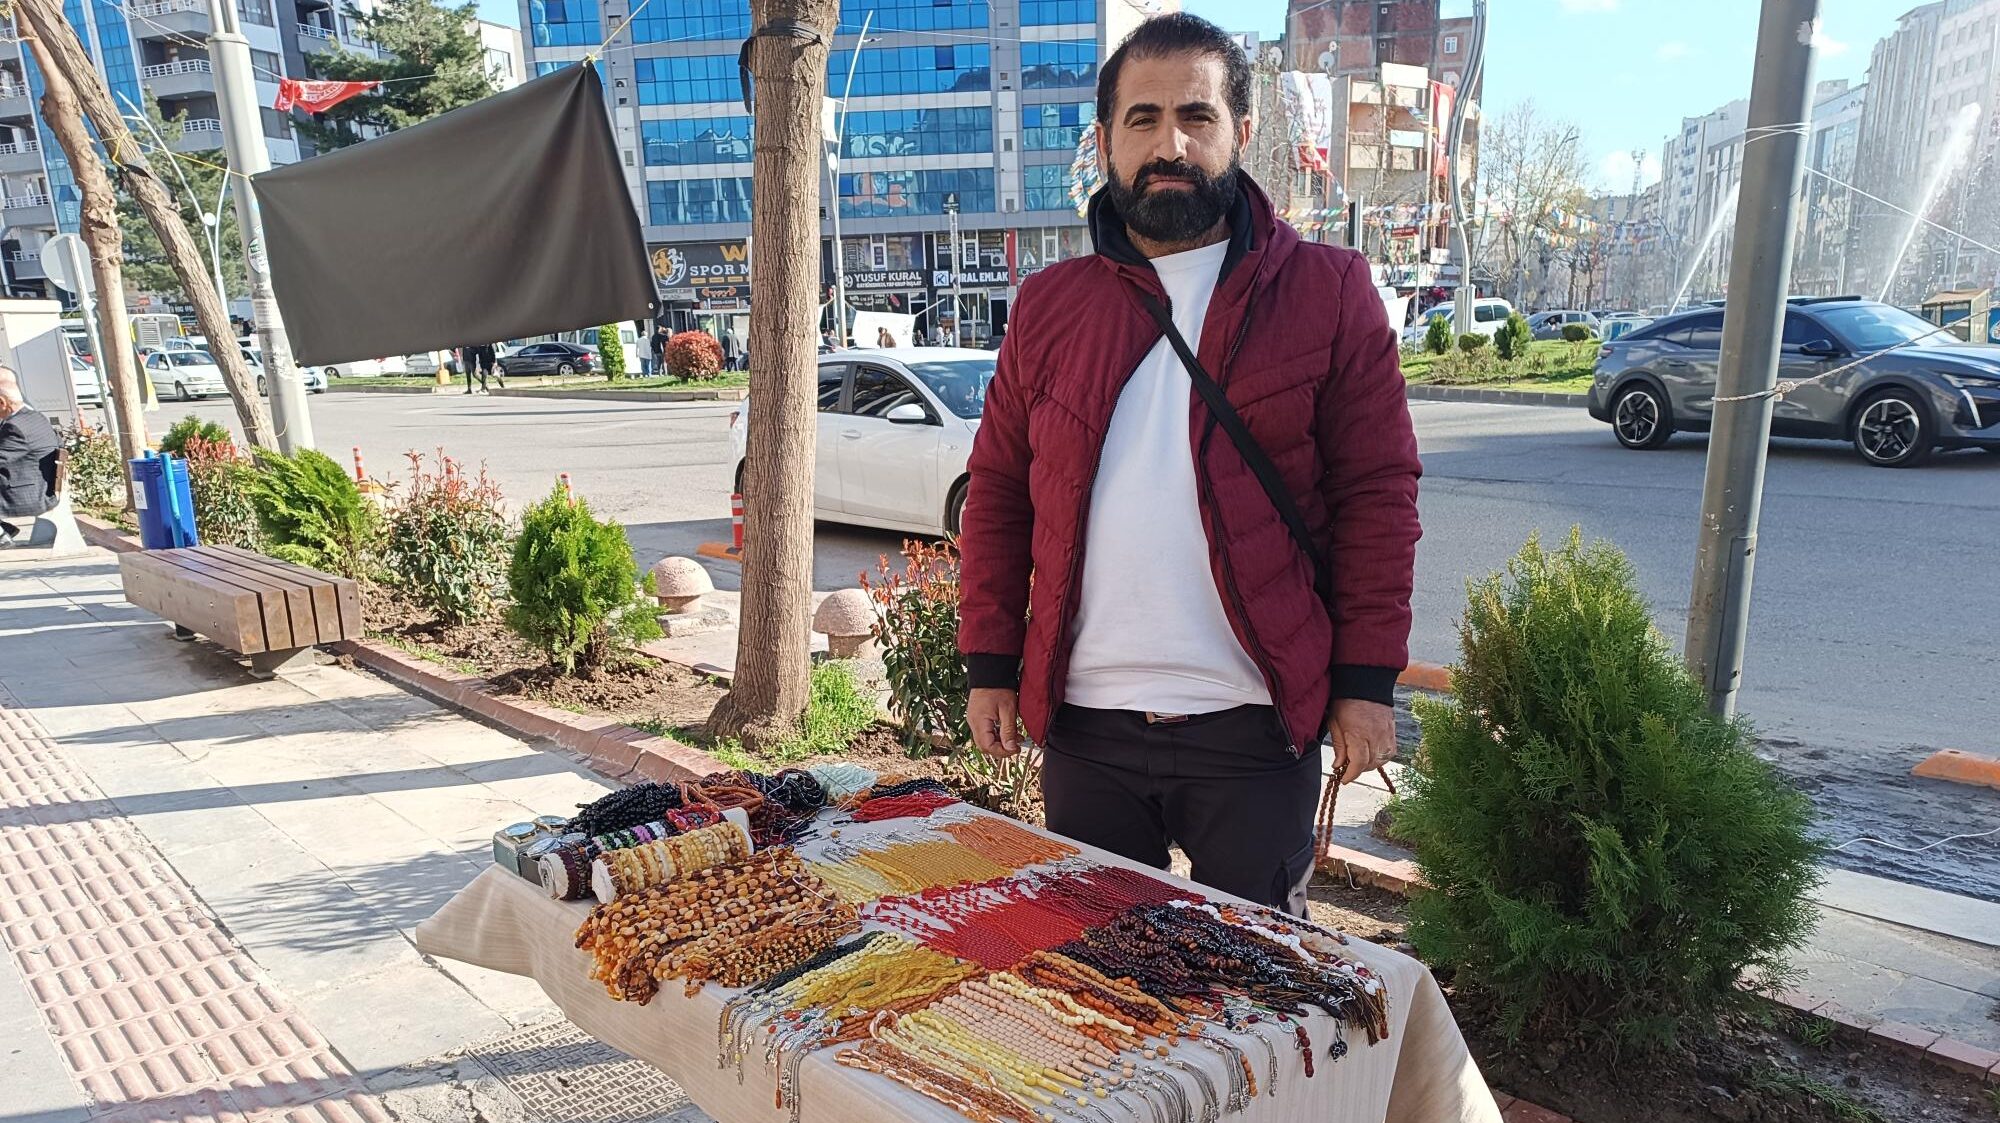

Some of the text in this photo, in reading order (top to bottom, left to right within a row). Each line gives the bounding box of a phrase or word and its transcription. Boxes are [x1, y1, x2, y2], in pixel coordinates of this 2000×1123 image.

[720, 245, 748, 262] W
[690, 264, 750, 276] SPOR M
[854, 272, 922, 283] YUSUF KURAL
[980, 272, 1009, 282] EMLAK
